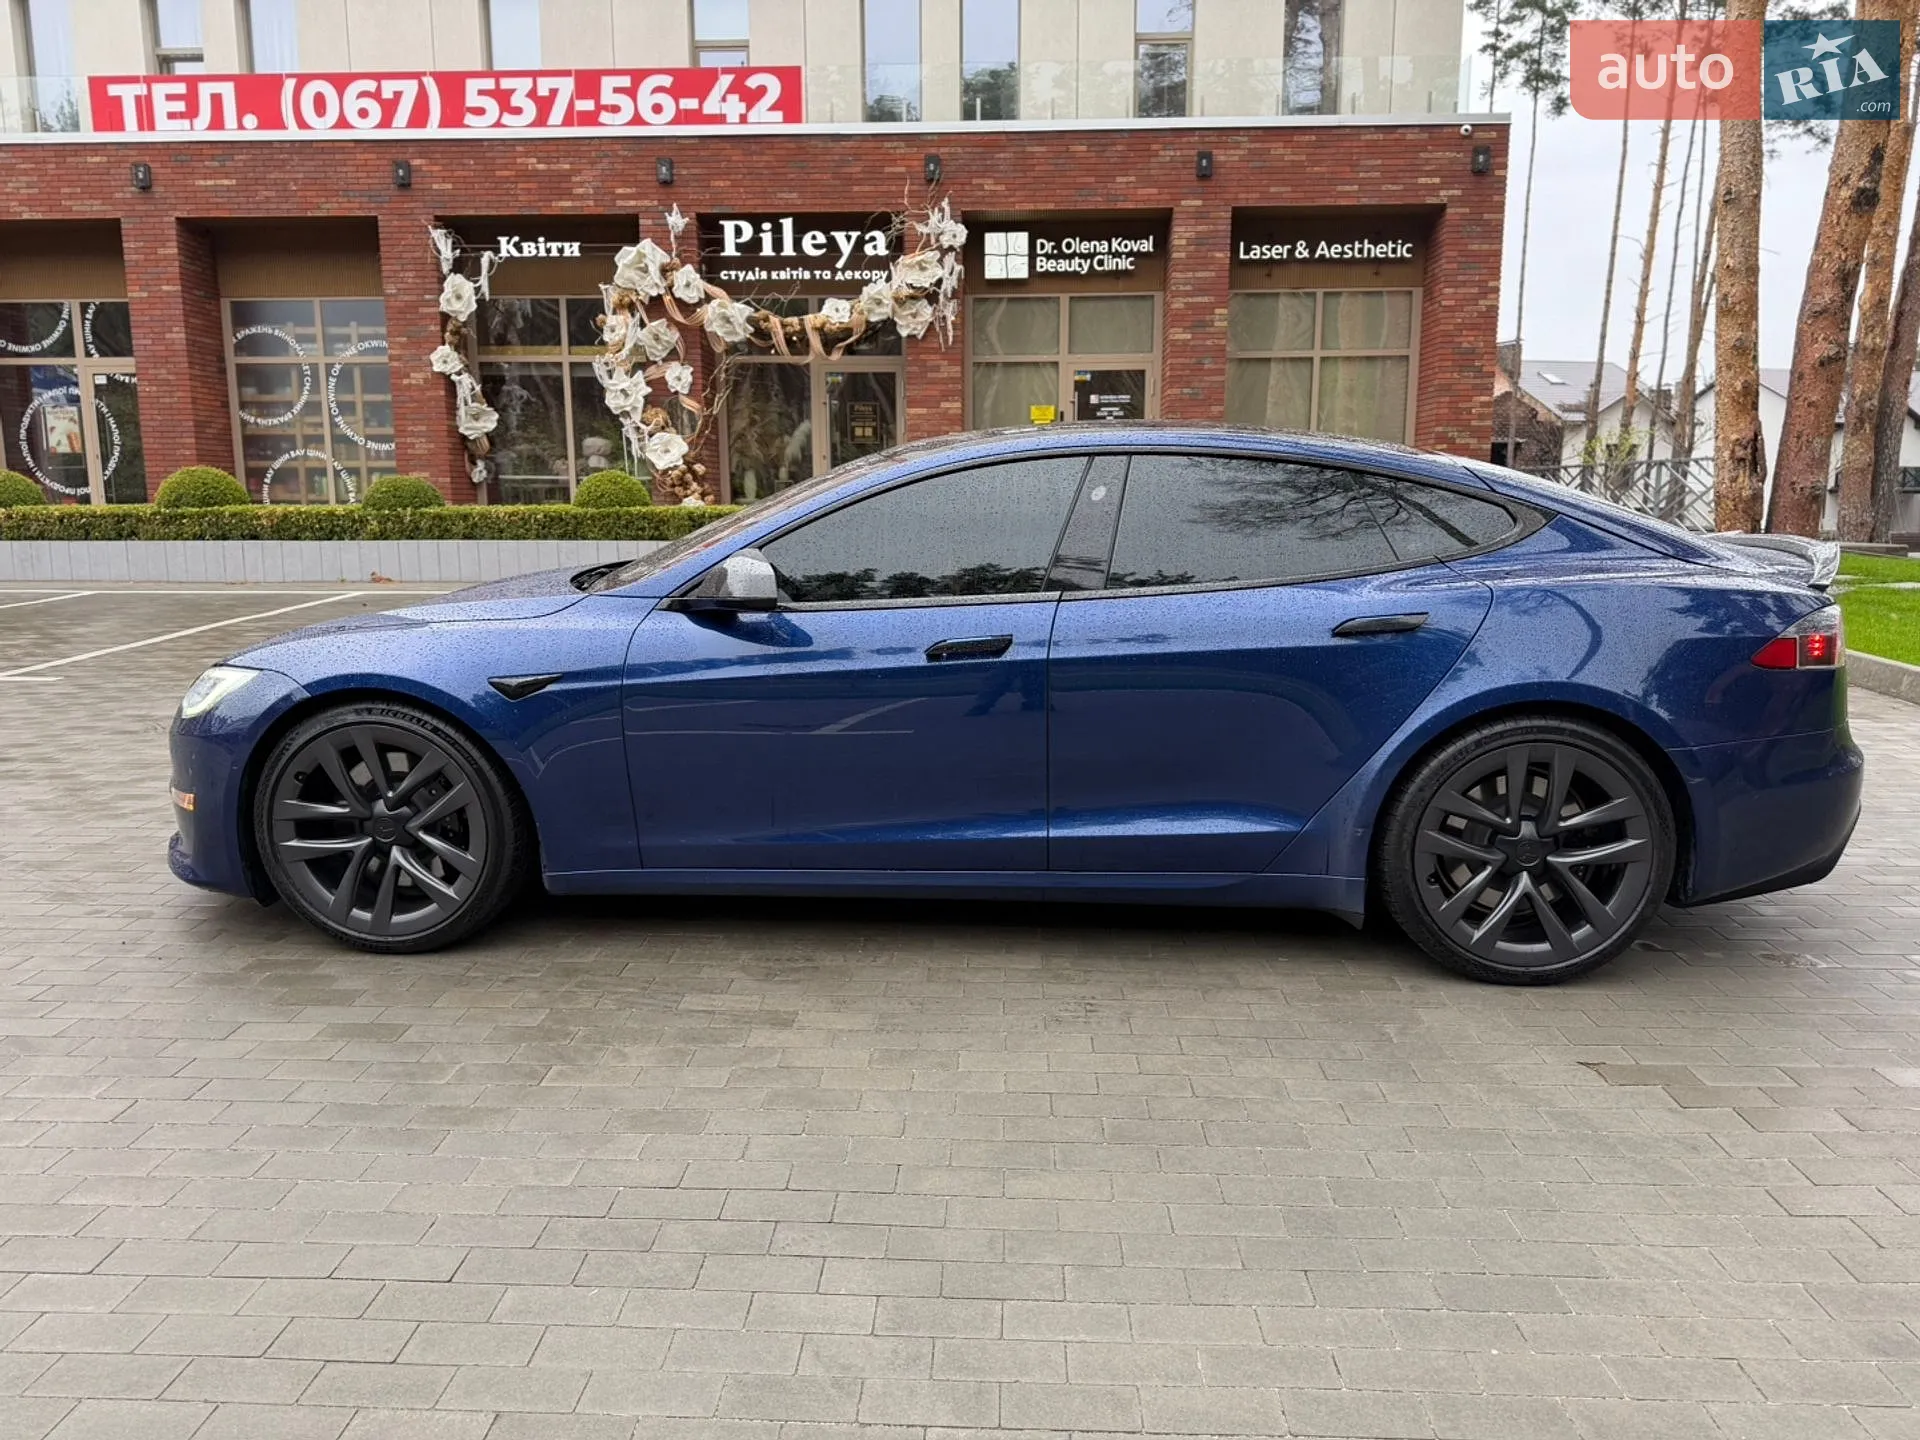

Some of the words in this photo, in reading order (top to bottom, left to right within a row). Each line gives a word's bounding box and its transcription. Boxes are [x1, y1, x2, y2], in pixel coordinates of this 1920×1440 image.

[107, 81, 258, 131] ТЕЛ.
[281, 76, 441, 131] (067)
[463, 73, 783, 128] 537-56-42
[497, 236, 581, 257] Квіти
[719, 217, 889, 269] Pileya
[1036, 238, 1058, 254] Dr.
[1062, 236, 1109, 254] Olena
[1111, 235, 1154, 252] Koval
[1239, 241, 1291, 259] Laser
[1294, 240, 1309, 259] &
[1315, 238, 1413, 258] Aesthetic
[720, 267, 768, 281] студія
[771, 267, 811, 280] квітів
[814, 270, 831, 280] та
[835, 269, 889, 282] декору
[1036, 256, 1091, 275] Beauty
[1093, 254, 1135, 271] Clinic
[327, 376, 339, 416] OKWINE
[334, 416, 365, 445] OKWINE
